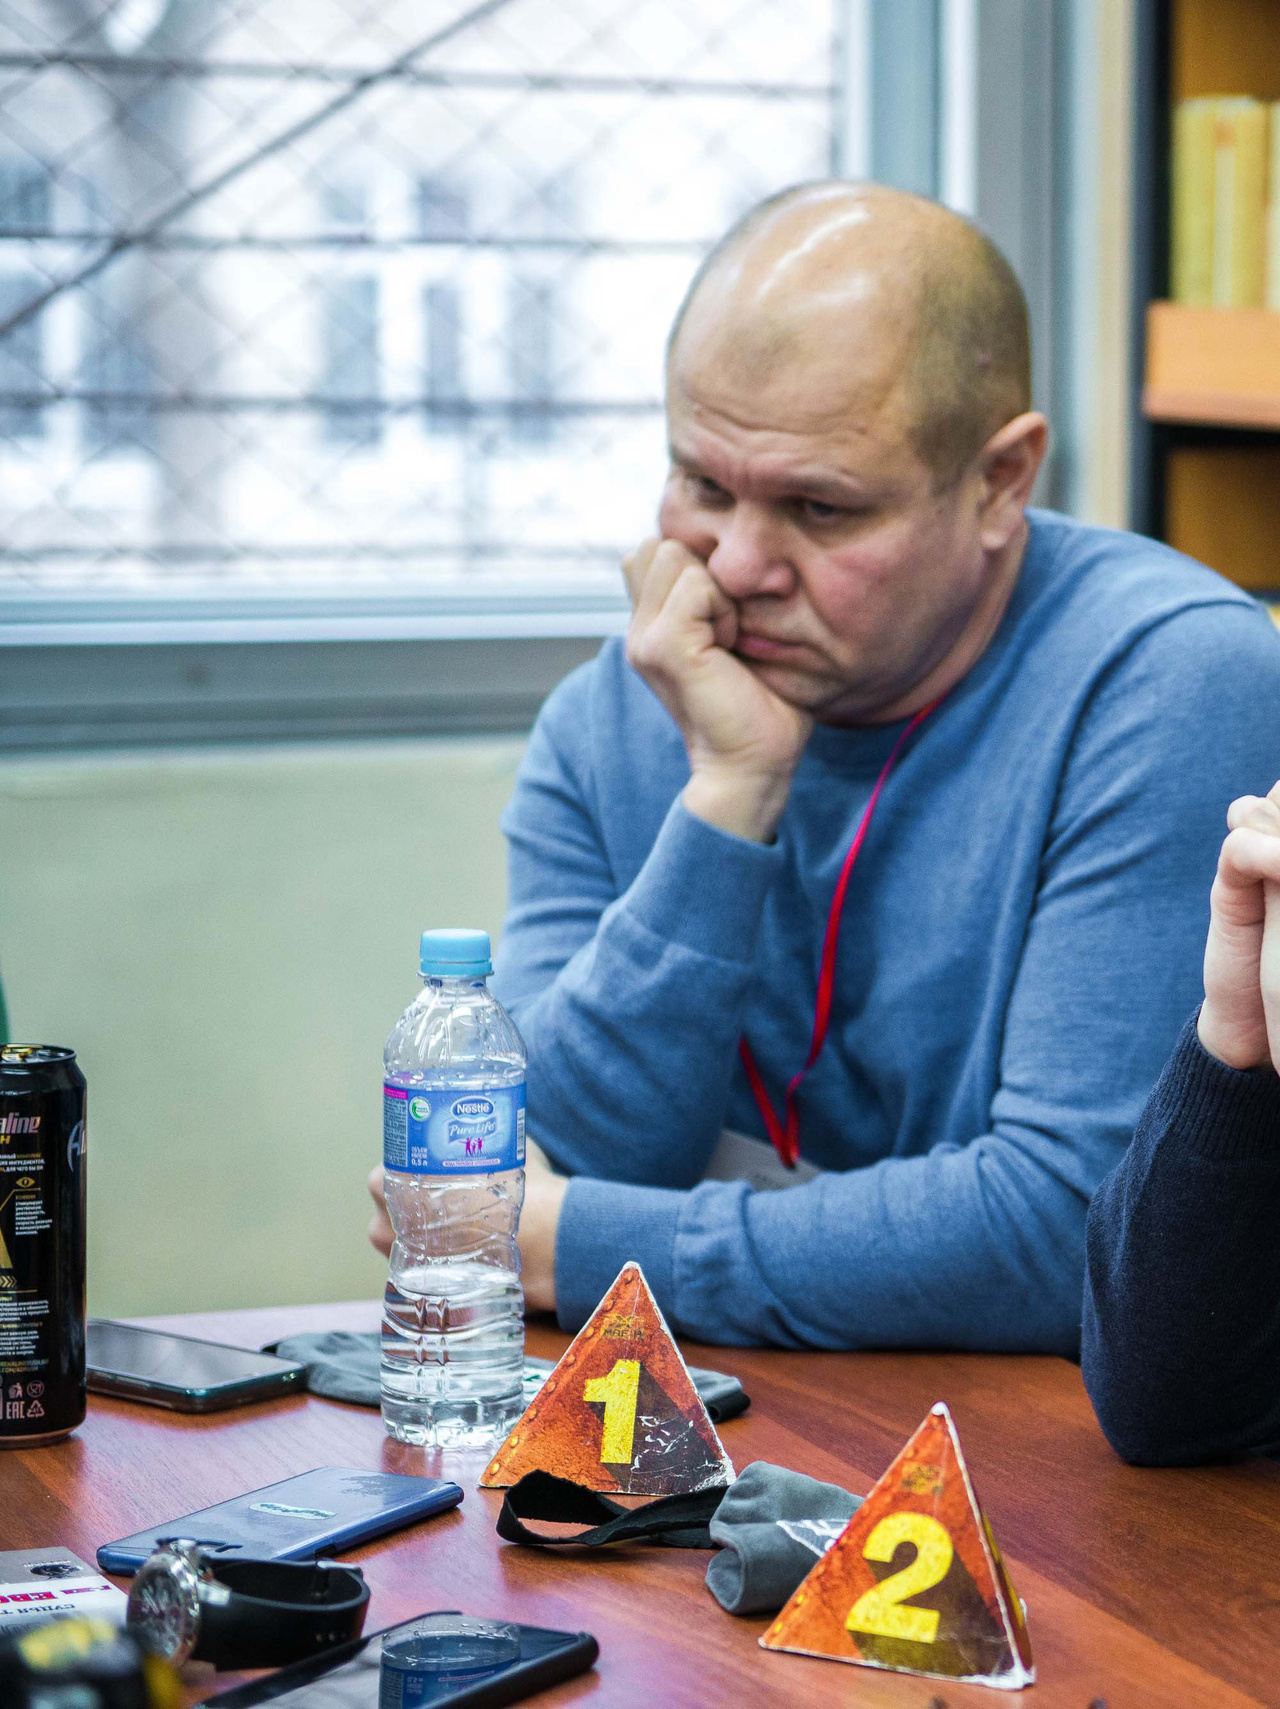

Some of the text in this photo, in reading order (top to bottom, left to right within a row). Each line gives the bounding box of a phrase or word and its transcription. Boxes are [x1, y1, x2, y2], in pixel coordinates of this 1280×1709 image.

[449, 1121, 494, 1137] Pure Life
[583, 1359, 641, 1464] 1
[845, 1511, 953, 1644] 2
